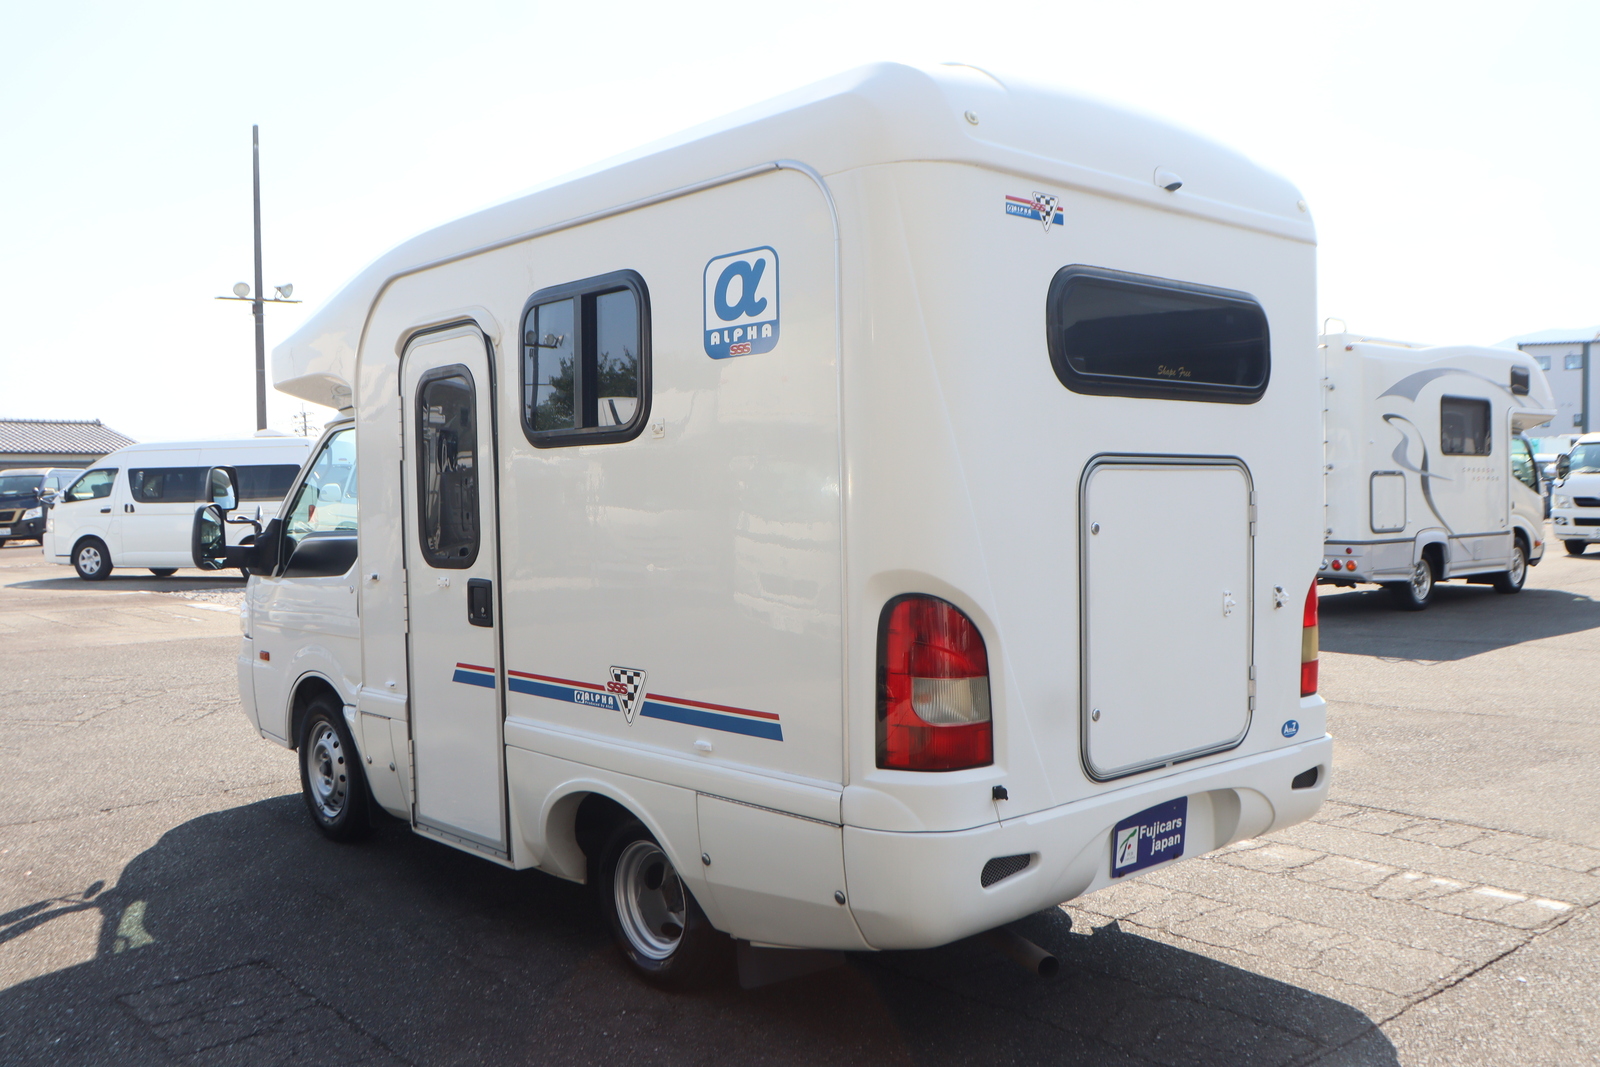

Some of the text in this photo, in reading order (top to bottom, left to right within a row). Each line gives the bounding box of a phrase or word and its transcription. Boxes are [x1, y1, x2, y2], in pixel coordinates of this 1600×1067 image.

[710, 323, 772, 346] ALPHA
[729, 342, 751, 356] SSS
[1157, 365, 1177, 378] Shape
[607, 682, 628, 695] SSS
[585, 692, 614, 705] ALPHA
[1139, 817, 1183, 839] Fujicars
[1150, 833, 1181, 856] japan
